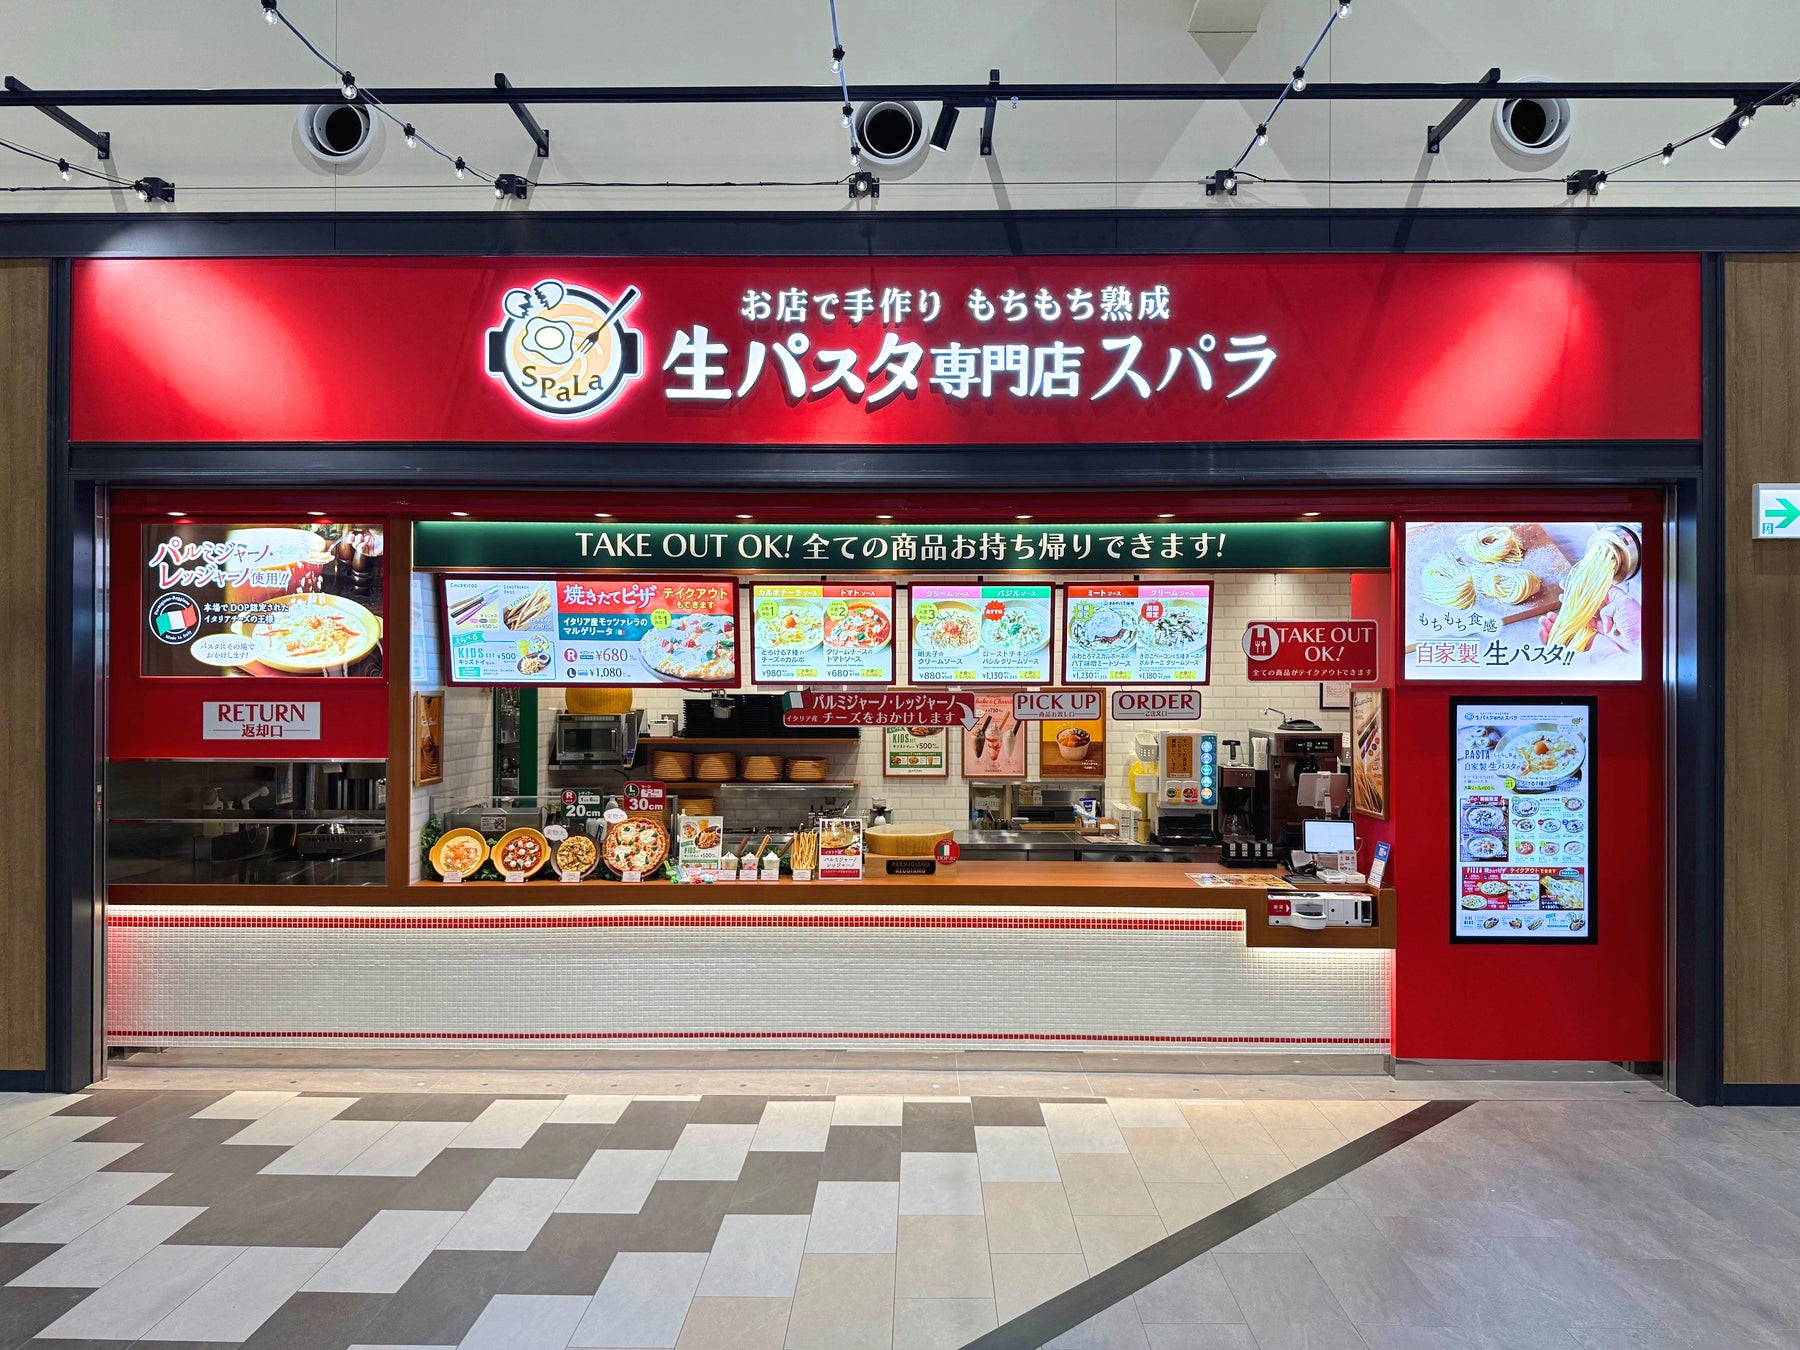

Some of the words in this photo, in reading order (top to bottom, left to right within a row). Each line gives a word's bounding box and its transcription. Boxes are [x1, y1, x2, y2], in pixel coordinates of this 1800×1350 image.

[740, 286, 943, 322] お店で手作り
[966, 285, 1172, 321] もちもち熟成
[574, 533, 650, 558] TAKE
[662, 533, 729, 558] OUT
[737, 534, 794, 559] OK!
[802, 531, 1227, 563] 全ての商品お持ち帰りできます!
[563, 583, 658, 609] 焼きたてピザ
[662, 587, 729, 600] テイクアウト
[676, 601, 716, 609] もできます
[204, 614, 275, 624] イタリアチーズの王様
[1419, 612, 1498, 633] もちもち食感
[563, 627, 613, 636] マルゲリータ
[1277, 627, 1326, 643] TAKE
[1330, 627, 1373, 643] OUT
[458, 647, 484, 659] KIDS
[595, 647, 628, 662] ¥680
[1304, 646, 1345, 662] OK!
[1417, 642, 1480, 664] 自家製
[589, 667, 622, 678] ¥1,080
[762, 669, 782, 678] ¥980
[827, 669, 849, 678] ¥680
[919, 671, 941, 680] ¥880
[982, 671, 1004, 680] ¥1,130
[1252, 669, 1373, 677] 全ての商品がテイクアウトできます
[1017, 694, 1064, 710] PICK
[1071, 694, 1097, 710] UP
[1118, 694, 1194, 710] ORDER
[218, 703, 306, 722] RETURN
[822, 711, 956, 725] チーズをおかけします
[241, 724, 284, 738] 返却口
[892, 733, 909, 743] KIDS
[1464, 749, 1490, 760] PASTA
[565, 804, 601, 817] 20cm
[629, 798, 664, 811] 30cm
